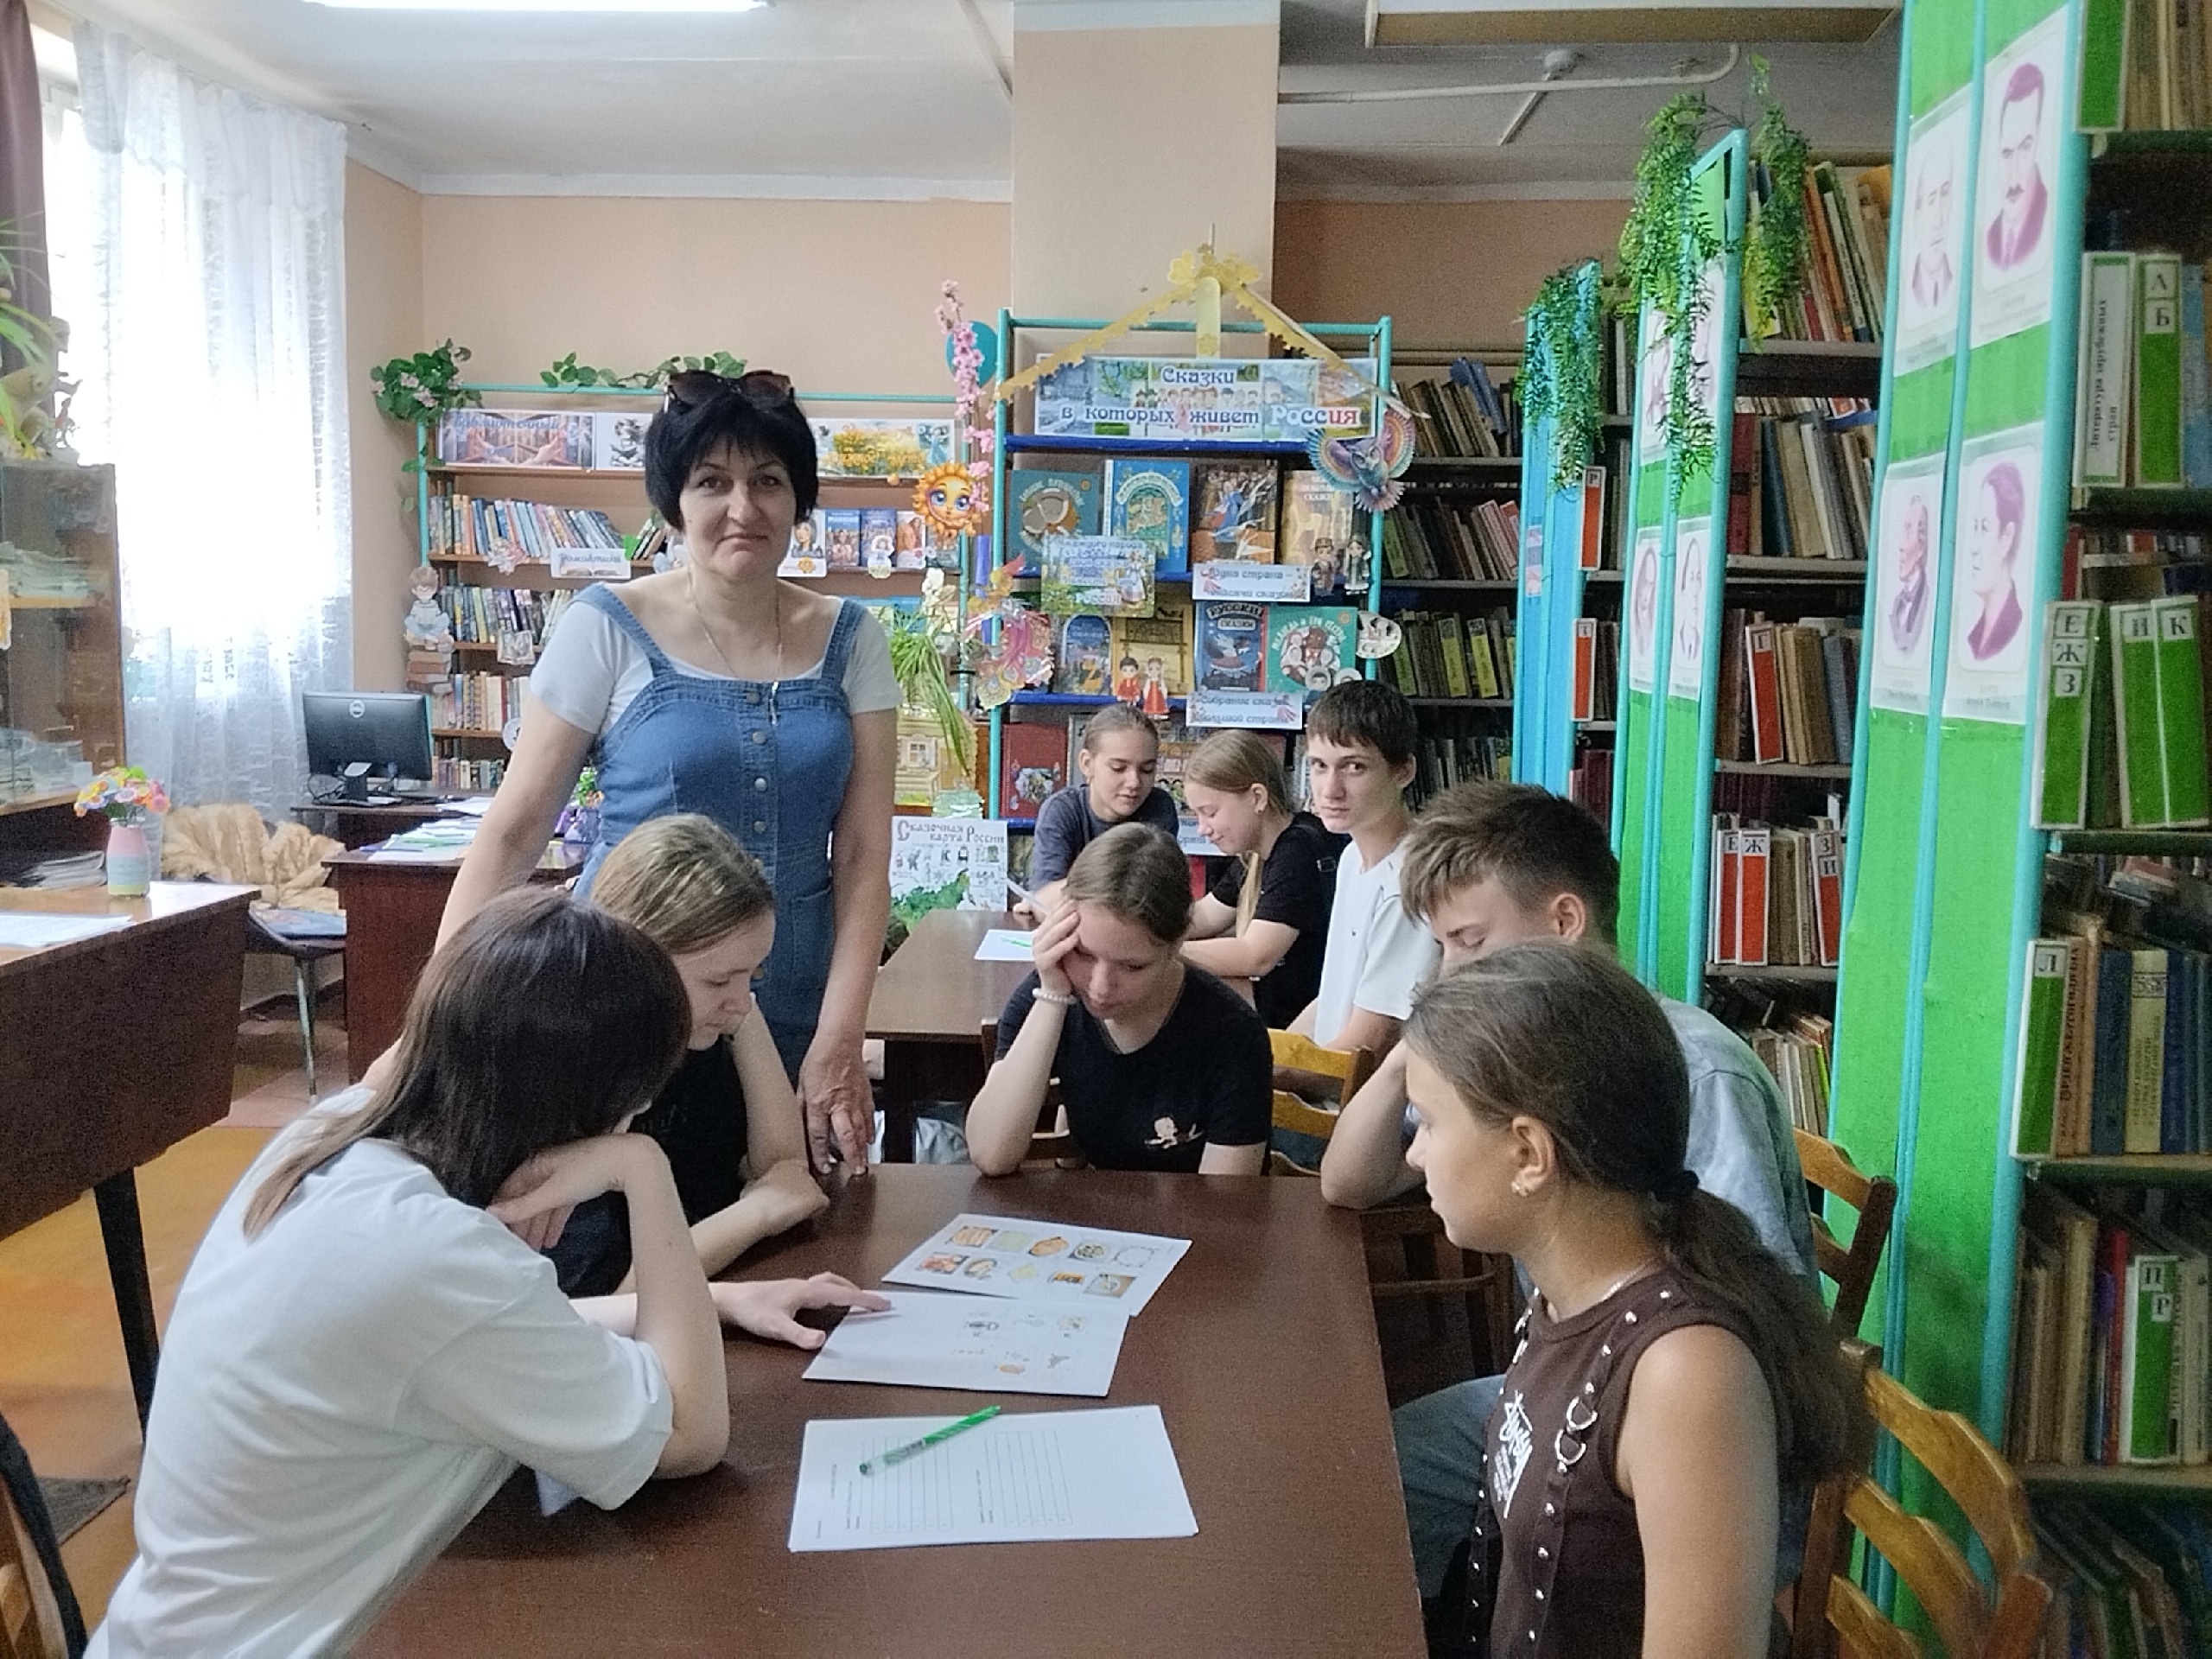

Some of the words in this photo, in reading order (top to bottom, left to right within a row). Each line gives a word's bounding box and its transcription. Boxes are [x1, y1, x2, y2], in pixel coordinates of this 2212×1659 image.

[2153, 307, 2170, 326] Б
[2094, 299, 2107, 372] зарубежных
[1162, 366, 1234, 386] Сказки
[1061, 407, 1073, 419] в
[1085, 407, 1175, 424] которых
[1190, 410, 1259, 423] живет
[1270, 404, 1358, 425] Россия
[2108, 406, 2117, 442] стран
[1242, 569, 1284, 580] страна
[2064, 614, 2079, 633] Е
[2131, 618, 2150, 637] И
[2170, 614, 2187, 635] К
[2056, 643, 2083, 662] Ж
[2062, 673, 2075, 693] З
[897, 820, 963, 842] Сказочная
[930, 833, 963, 843] карта
[966, 825, 1005, 843] России
[1728, 836, 1738, 851] Е
[1745, 839, 1764, 853] Ж
[1821, 837, 1829, 852] З
[2037, 953, 2057, 973] Л
[2157, 1298, 2170, 1316] Р
